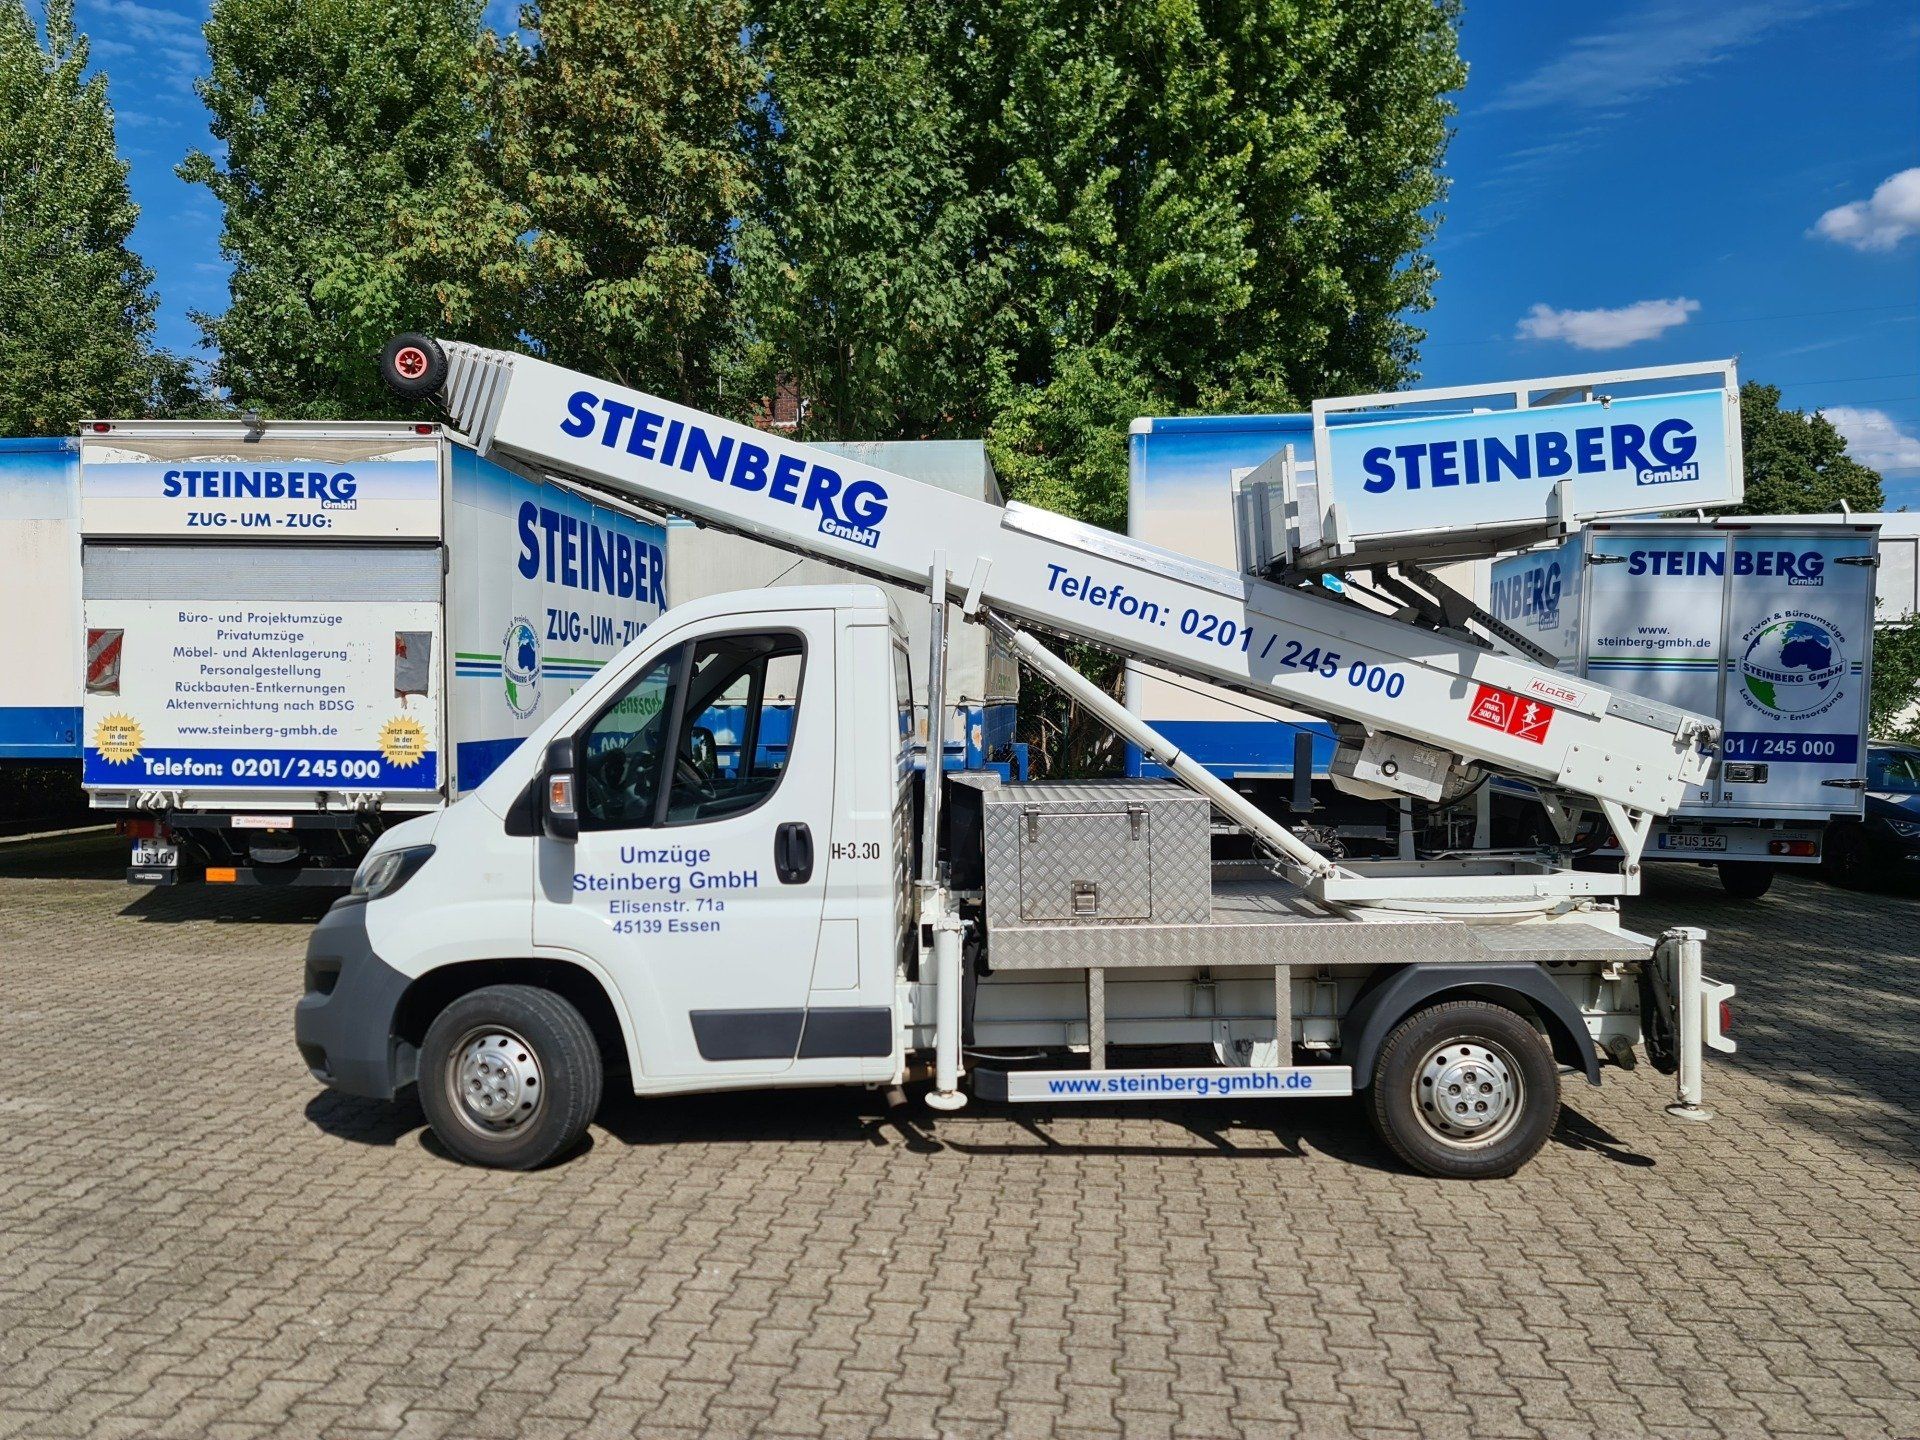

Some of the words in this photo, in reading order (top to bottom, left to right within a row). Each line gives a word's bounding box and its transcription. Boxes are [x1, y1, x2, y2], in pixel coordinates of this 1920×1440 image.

[1362, 418, 1697, 494] STEINBERG
[1639, 464, 1696, 485] GmbH
[559, 391, 889, 529] STEINBERG
[822, 520, 877, 546] GmbH
[162, 470, 357, 500] STEINBERG
[322, 500, 356, 509] GmbH
[517, 500, 666, 604] STEINBER
[1628, 551, 1824, 577] STEINBERG
[1789, 577, 1823, 586] GmbH
[1491, 562, 1561, 620] INBERG
[178, 611, 213, 623] Büro-
[218, 612, 242, 623] und
[248, 613, 343, 626] Projektumzüge
[1742, 617, 1771, 641] Privat
[1785, 610, 1846, 643] Büroumzüge
[217, 630, 304, 643] Privatumzüge
[1046, 563, 1170, 627] Telefon:
[1180, 608, 1253, 652] 0201
[1280, 640, 1341, 679] 245
[1348, 661, 1405, 699] 000
[1638, 626, 1670, 635] www.
[1597, 636, 1711, 649] steinberg-gmbh.de
[173, 647, 218, 658] Möbel-
[223, 647, 247, 658] und
[252, 647, 347, 661] Aktenlagerung
[200, 665, 321, 678] Personalgestellung
[1743, 662, 1804, 683] STEINBERG
[1808, 665, 1843, 681] GmbH
[175, 681, 346, 696] Rückbauten-Entkernungen
[166, 699, 279, 713] Aktenvernichtung
[284, 700, 314, 711] nach
[319, 700, 355, 711] BDSG
[1484, 702, 1500, 713] max.
[1739, 688, 1780, 721] Lagerung
[1790, 691, 1844, 720] Entsorgung
[1478, 709, 1491, 719] 300
[1491, 713, 1500, 723] kg
[177, 725, 338, 738] www.steinberg-gmbh.de
[1725, 738, 1745, 753] 01
[1763, 740, 1796, 755] 245
[1802, 741, 1835, 755] 000
[144, 757, 223, 776] Telefon:
[141, 840, 148, 850] E
[1670, 836, 1677, 846] E
[1702, 836, 1721, 847] 154
[136, 852, 151, 864] US
[154, 852, 175, 864] 109
[620, 844, 711, 866] Umzüge
[831, 842, 880, 860] H=3.30
[572, 872, 681, 893] Steinberg
[689, 871, 758, 889] GmbH
[609, 899, 690, 913] Elisenstr.
[696, 898, 724, 912] 71a
[612, 919, 662, 934] 45139
[669, 919, 720, 933] Essen
[1049, 1071, 1312, 1095] www.steinberg-gmbh.de
